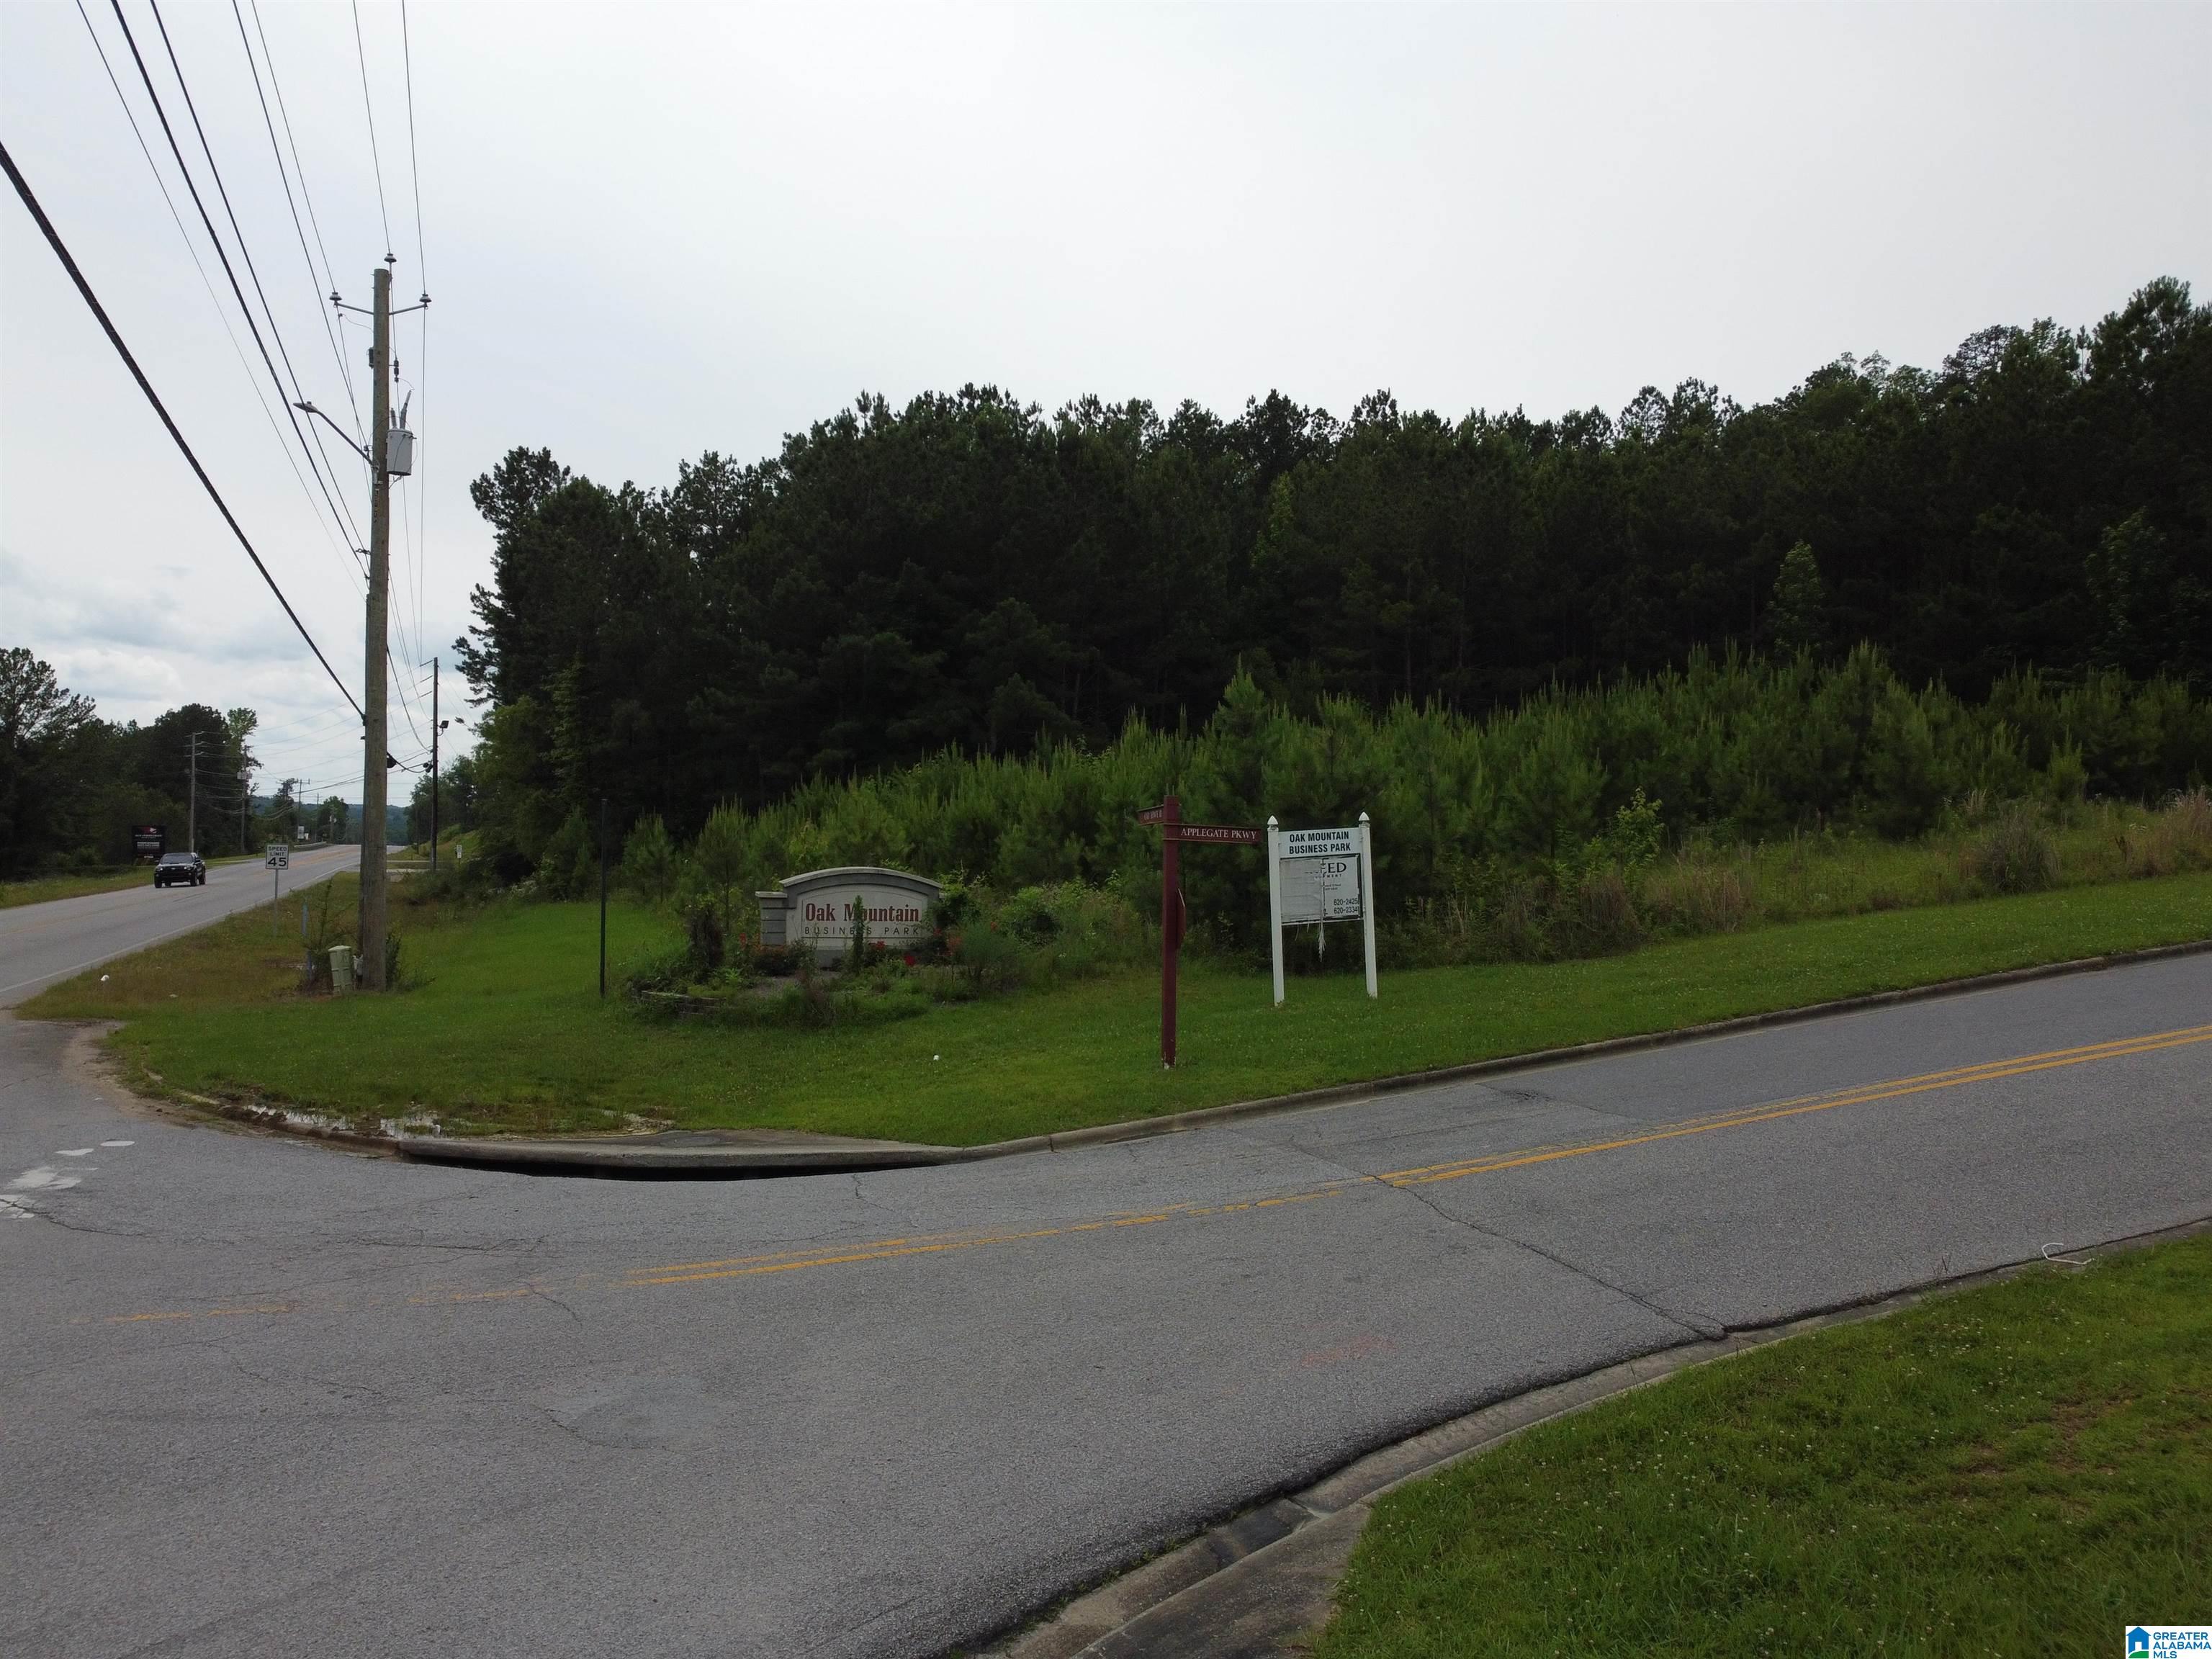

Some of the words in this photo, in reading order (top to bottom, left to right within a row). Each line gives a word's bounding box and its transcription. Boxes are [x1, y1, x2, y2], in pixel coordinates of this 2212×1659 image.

[1181, 827, 1228, 837] APPLEGATE
[1231, 830, 1256, 839] PKWY
[1290, 834, 1305, 842] OAK
[1308, 831, 1349, 841] MOUNTAIN
[1289, 844, 1328, 854] BUSINESS
[1330, 842, 1351, 852] PARK
[267, 857, 287, 866] 45
[805, 903, 836, 922] Oak
